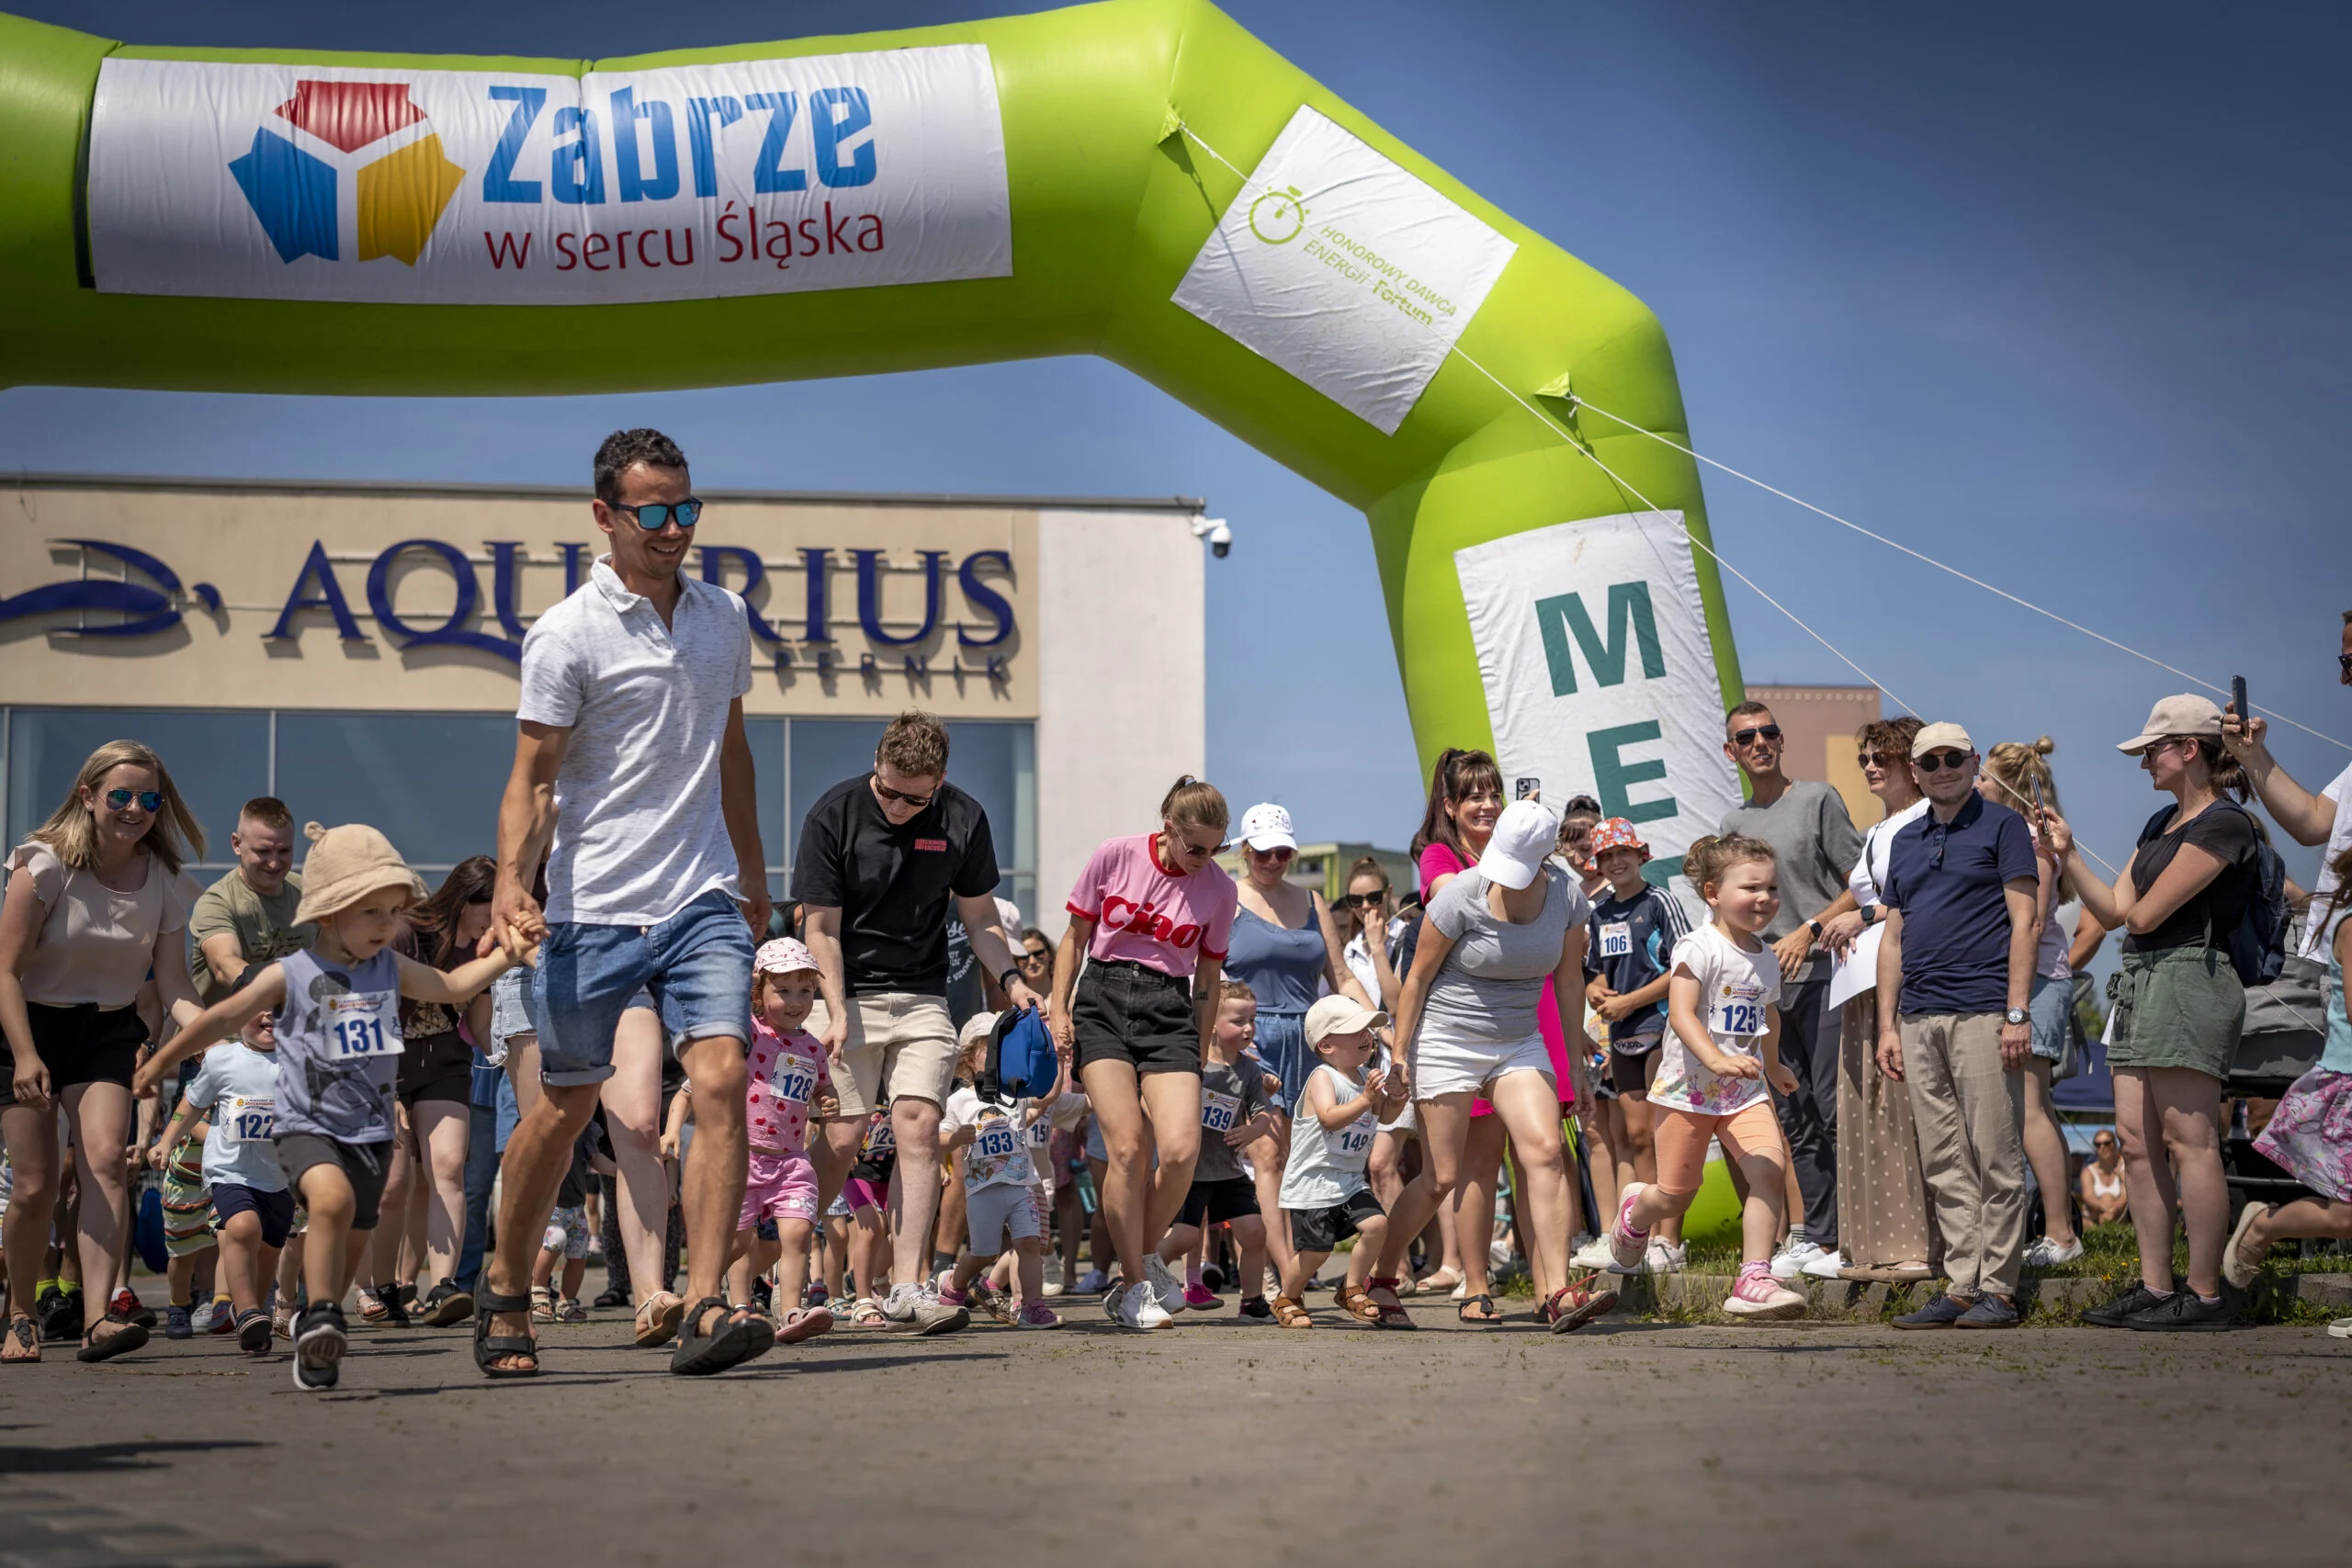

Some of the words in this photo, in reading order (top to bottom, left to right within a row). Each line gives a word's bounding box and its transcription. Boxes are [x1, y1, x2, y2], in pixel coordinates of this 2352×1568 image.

[482, 85, 877, 205] Zabrze
[484, 231, 532, 269] w
[555, 227, 695, 271] sercu
[717, 200, 884, 269] Śląska
[1320, 225, 1408, 283] HONOROWY
[1405, 278, 1457, 317] DAWCA
[260, 537, 1014, 666] AQURIUS
[774, 650, 1004, 682] PERNIK
[1102, 895, 1201, 949] Ciao
[1604, 935, 1627, 953] 106
[1722, 1004, 1758, 1033] 125
[334, 1018, 385, 1055] 131
[783, 1073, 813, 1102] 128
[235, 1114, 273, 1139] 122
[1203, 1105, 1232, 1131] 139
[978, 1132, 1013, 1156] 133
[1341, 1131, 1369, 1152] 149
